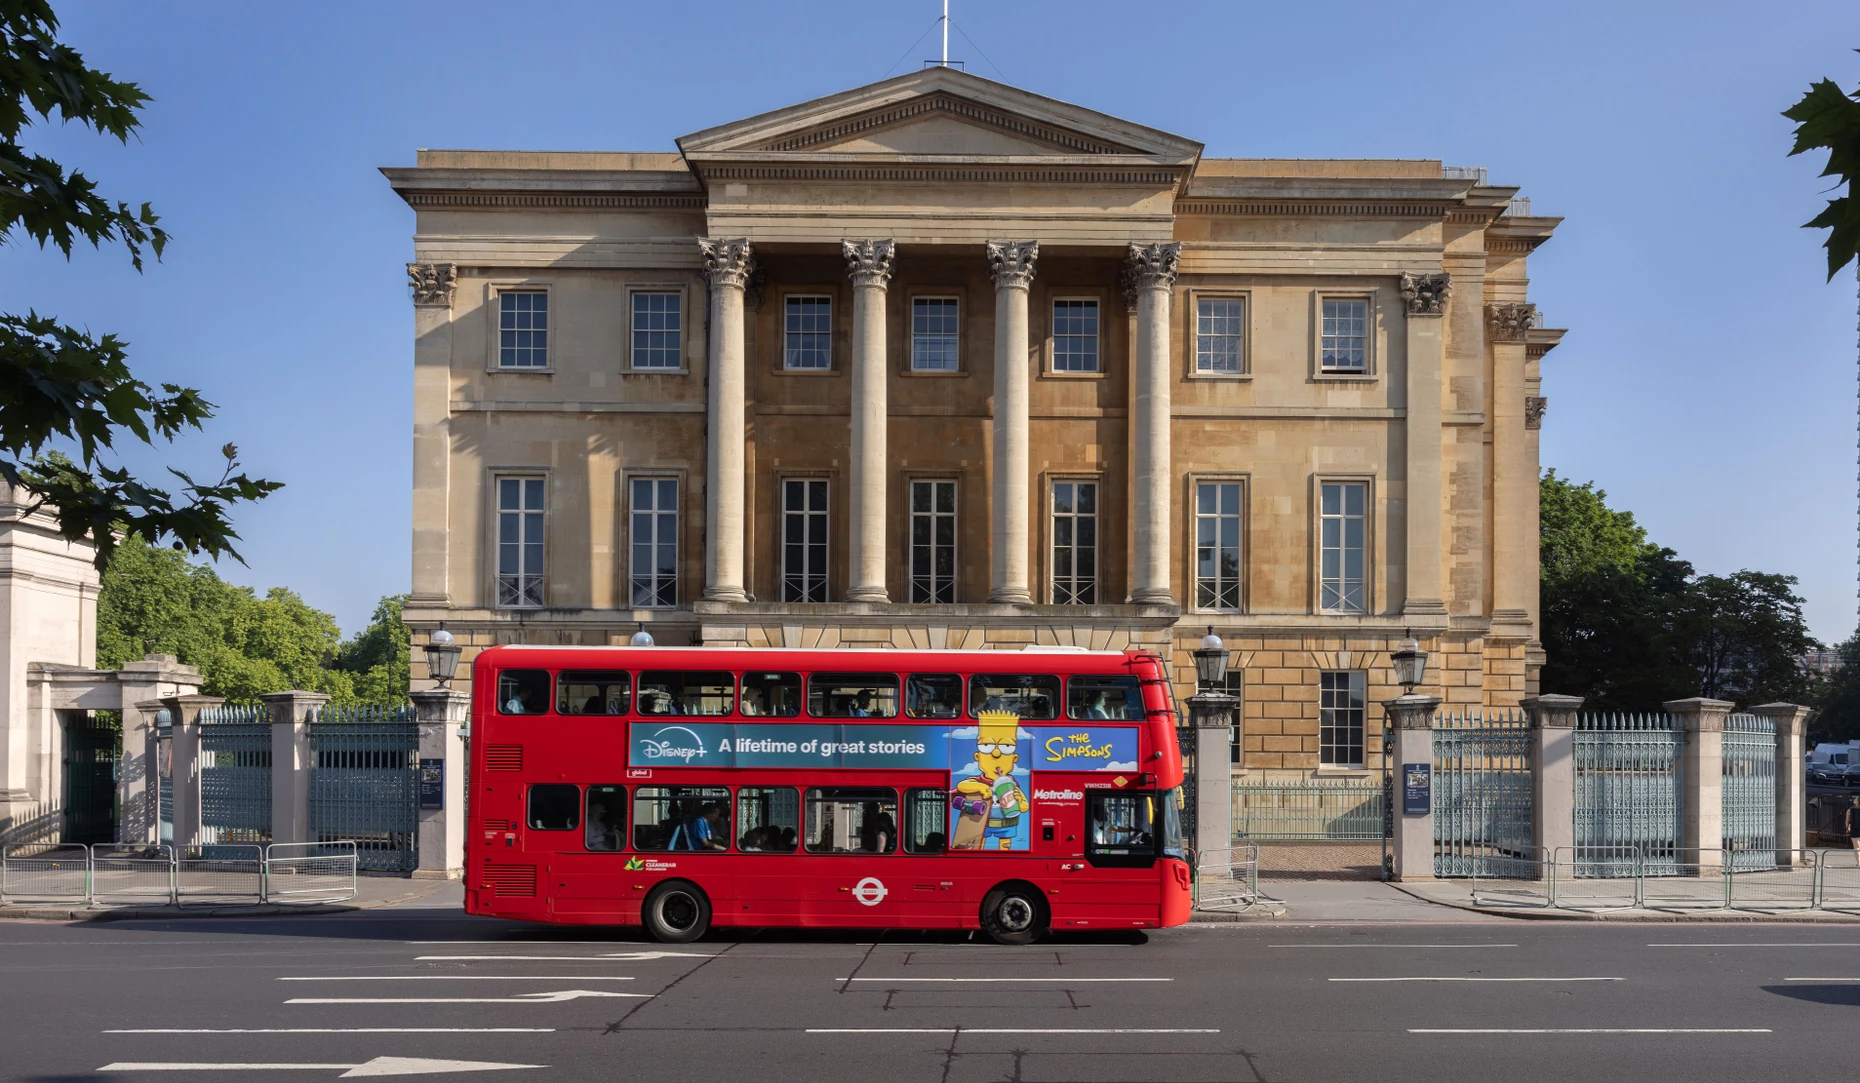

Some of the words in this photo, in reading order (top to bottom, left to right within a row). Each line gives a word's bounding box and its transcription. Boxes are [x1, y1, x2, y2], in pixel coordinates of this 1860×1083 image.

[718, 738, 732, 753] A
[735, 738, 798, 753] lifetime
[800, 739, 818, 753] of
[820, 740, 866, 757] great
[868, 739, 926, 754] stories
[1033, 788, 1084, 800] Metroline
